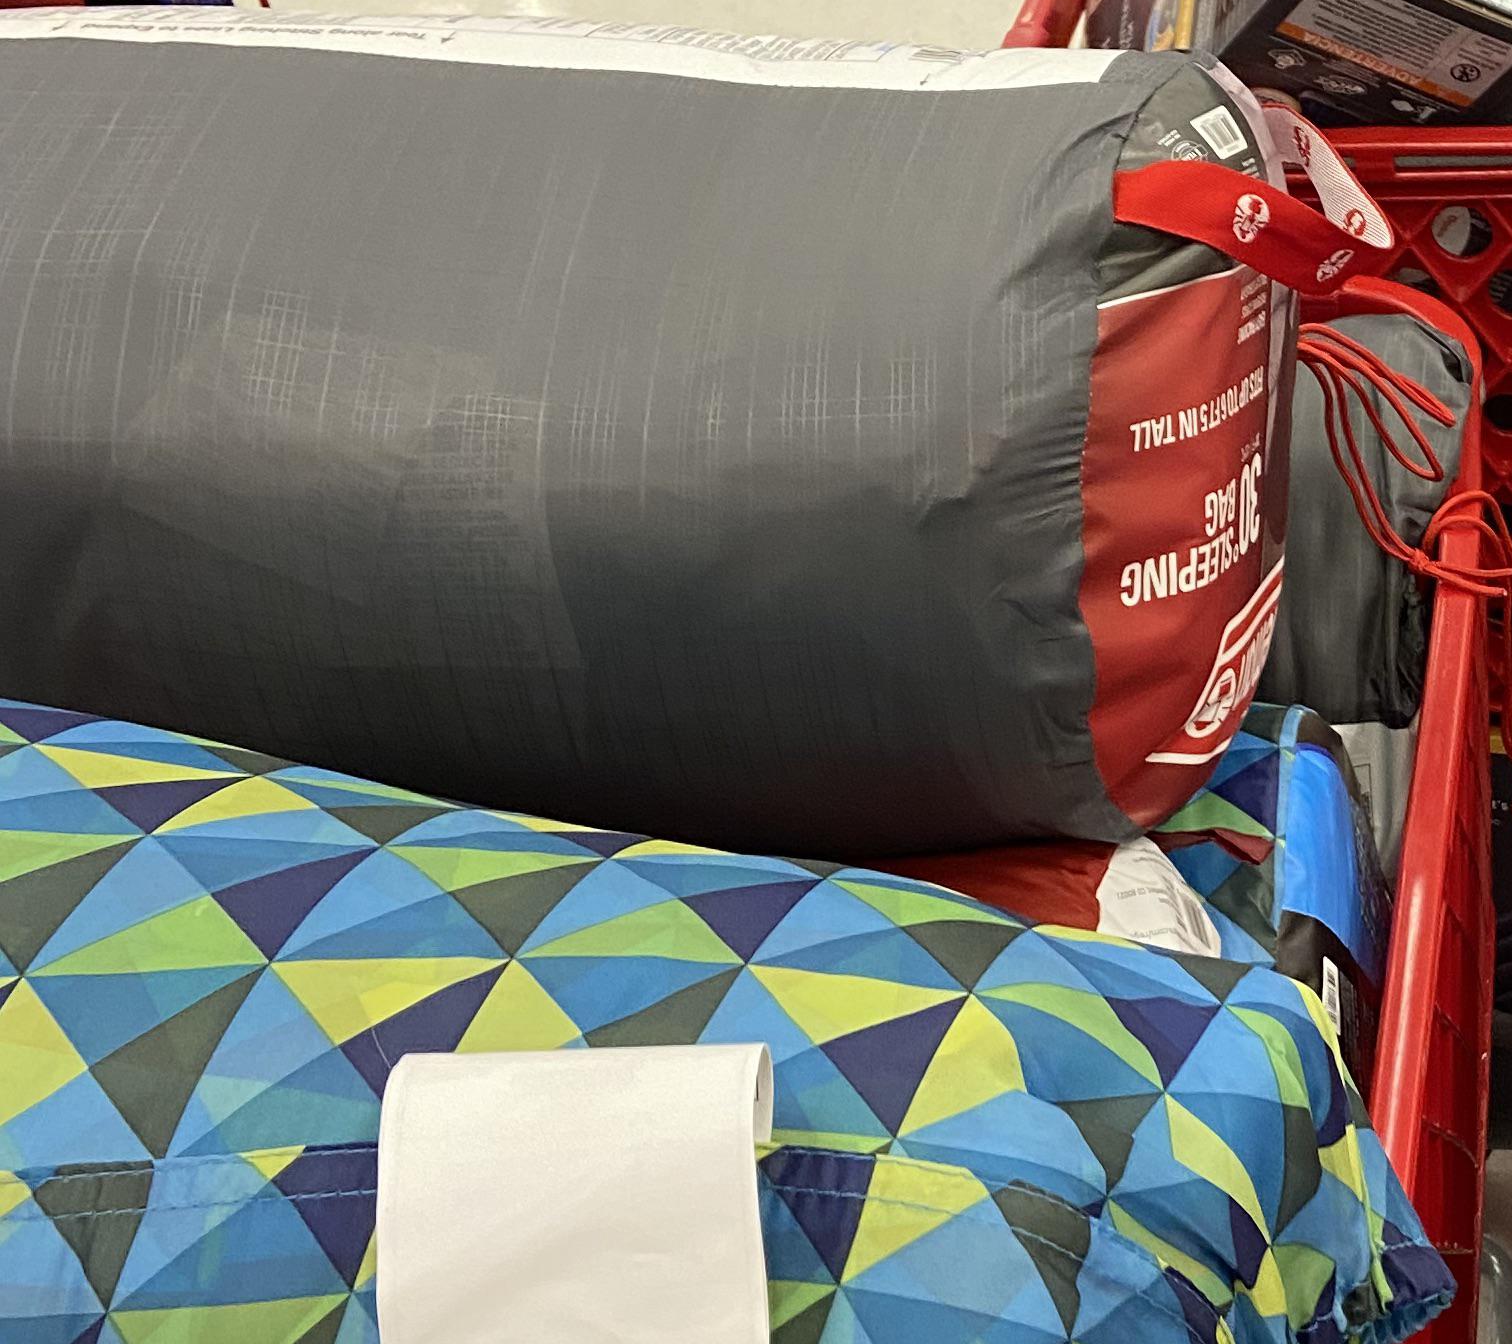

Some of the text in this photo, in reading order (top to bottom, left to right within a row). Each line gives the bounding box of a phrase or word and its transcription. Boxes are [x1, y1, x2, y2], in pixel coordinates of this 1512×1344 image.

[1249, 365, 1265, 400] FITS
[1129, 414, 1176, 453] TALL
[1178, 407, 1199, 441] IN
[1205, 478, 1236, 537] BAG
[1120, 525, 1235, 608] SLEEPING
